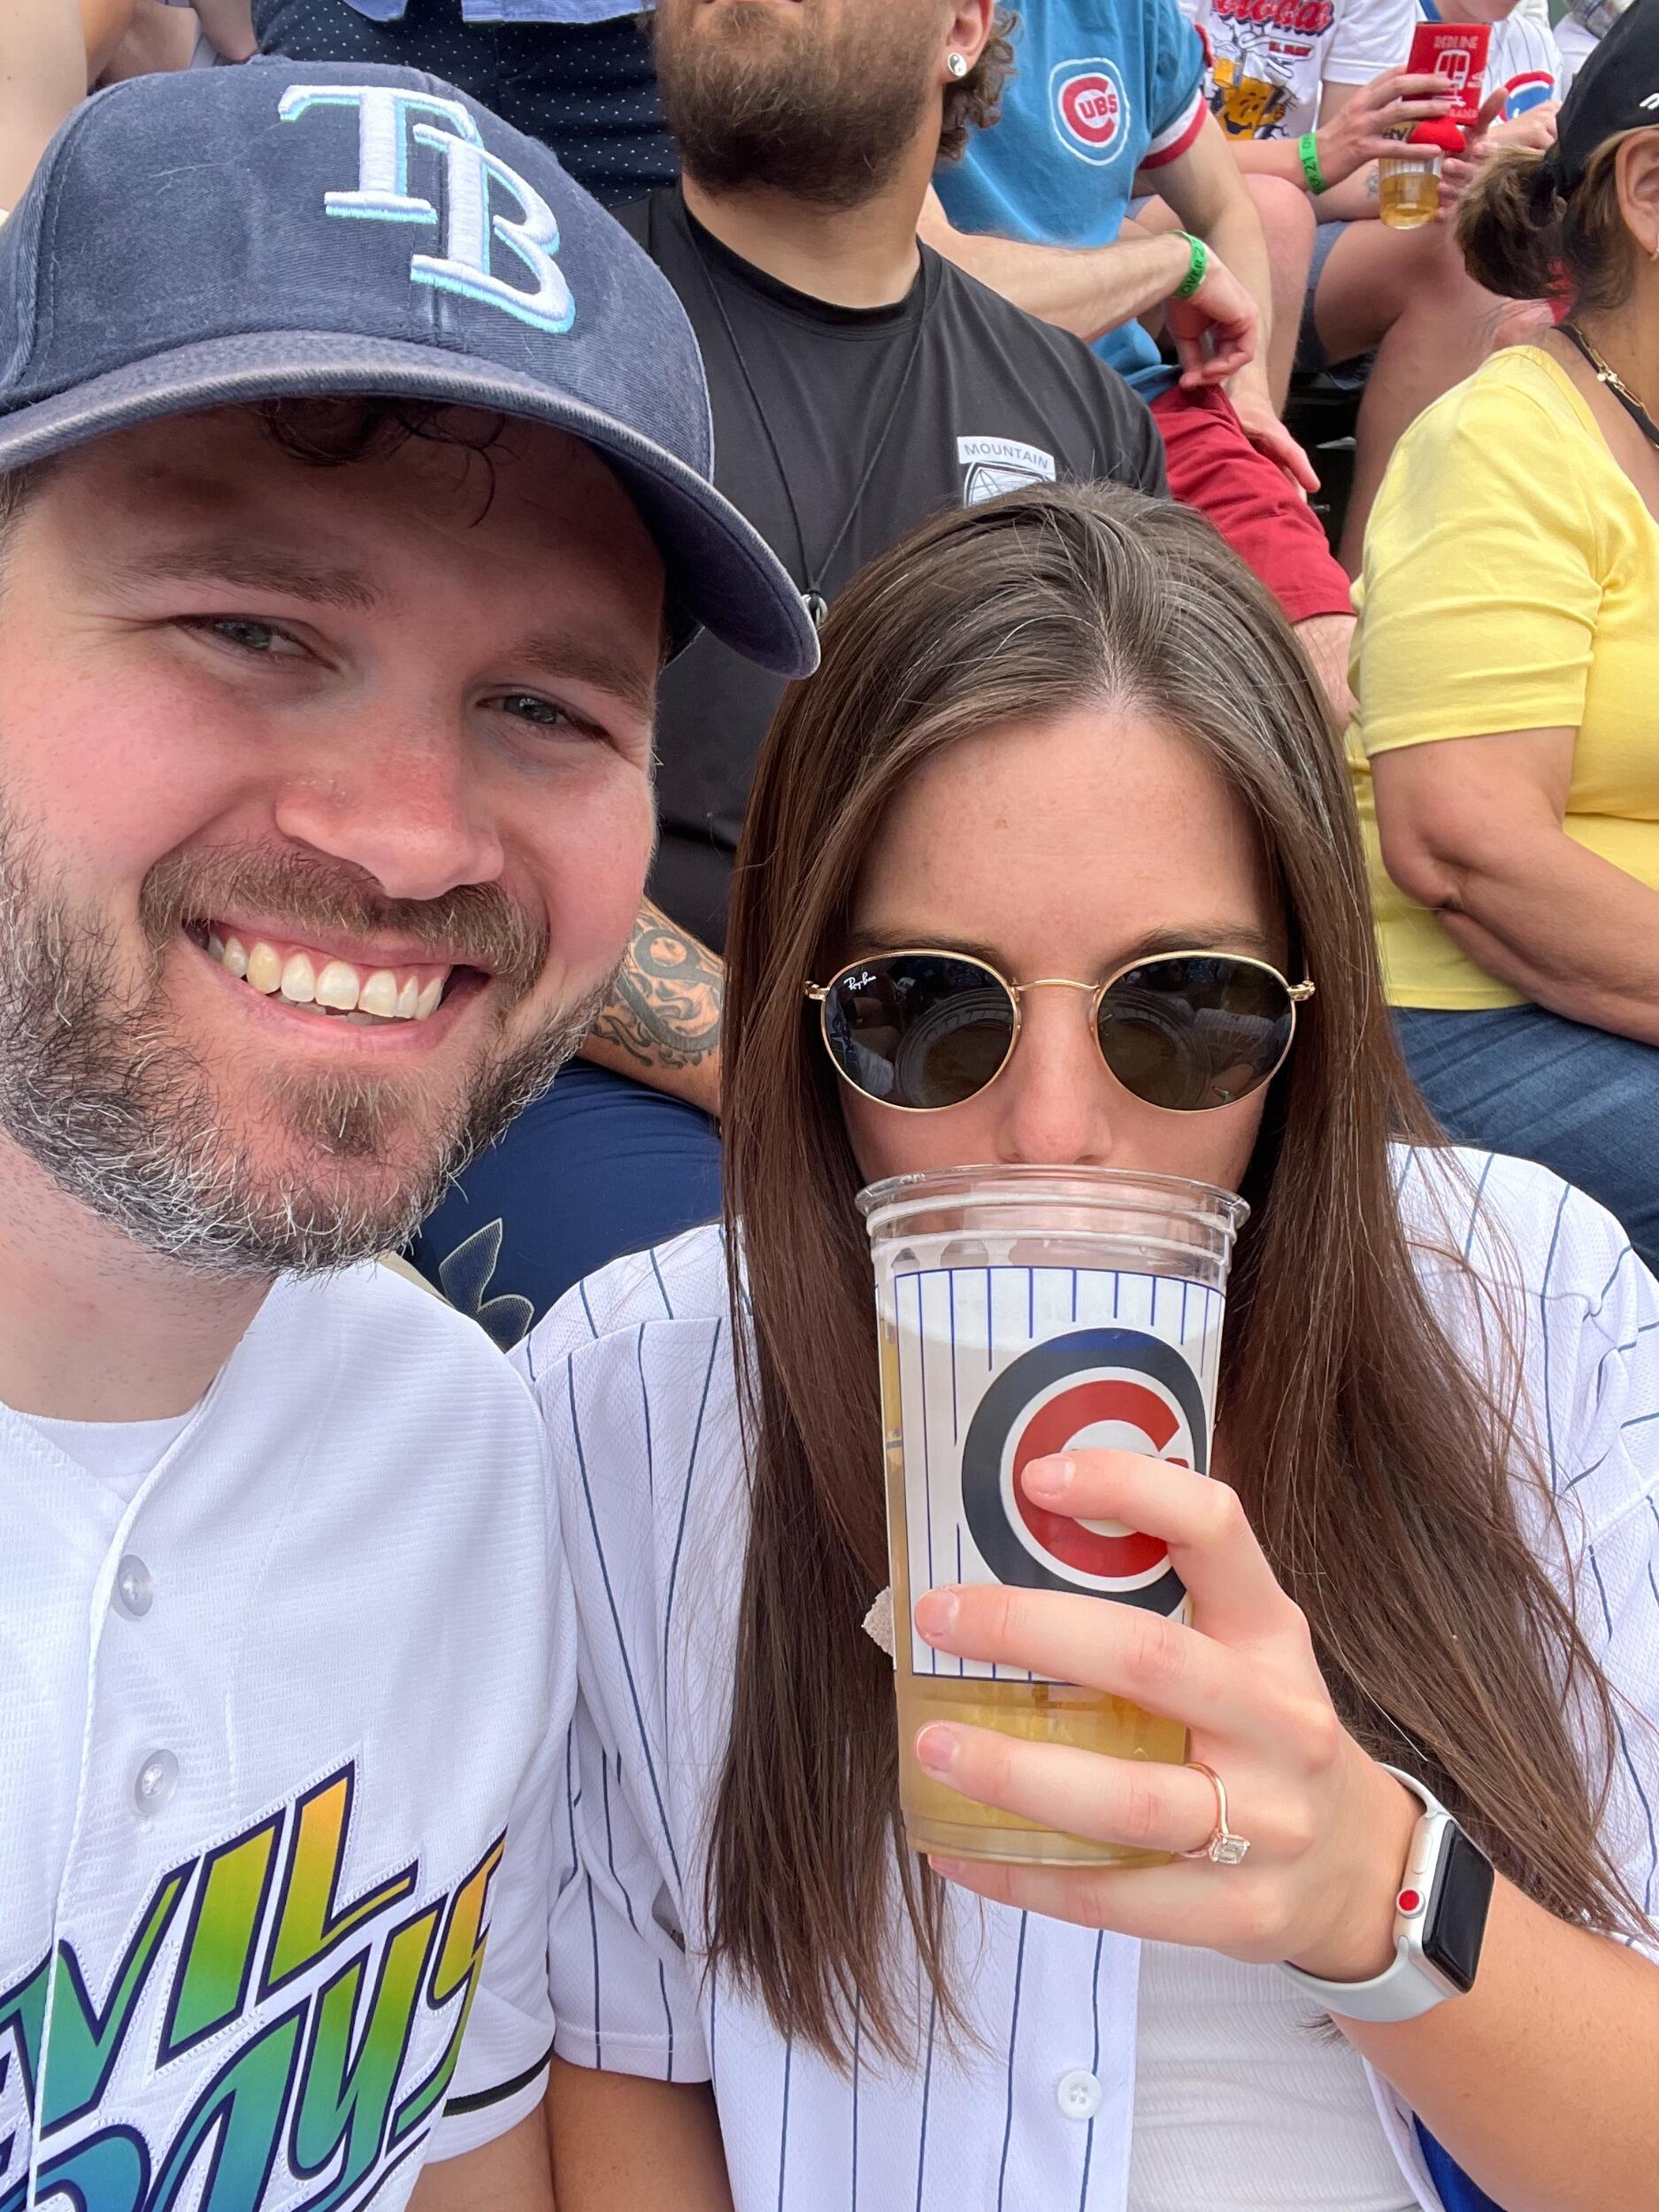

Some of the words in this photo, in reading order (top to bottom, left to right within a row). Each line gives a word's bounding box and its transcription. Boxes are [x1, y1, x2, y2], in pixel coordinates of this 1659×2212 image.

[1063, 76, 1118, 143] CUBS
[278, 85, 576, 334] TB
[964, 442, 1048, 470] MOUNTAIN
[0, 1760, 419, 2143] VIL
